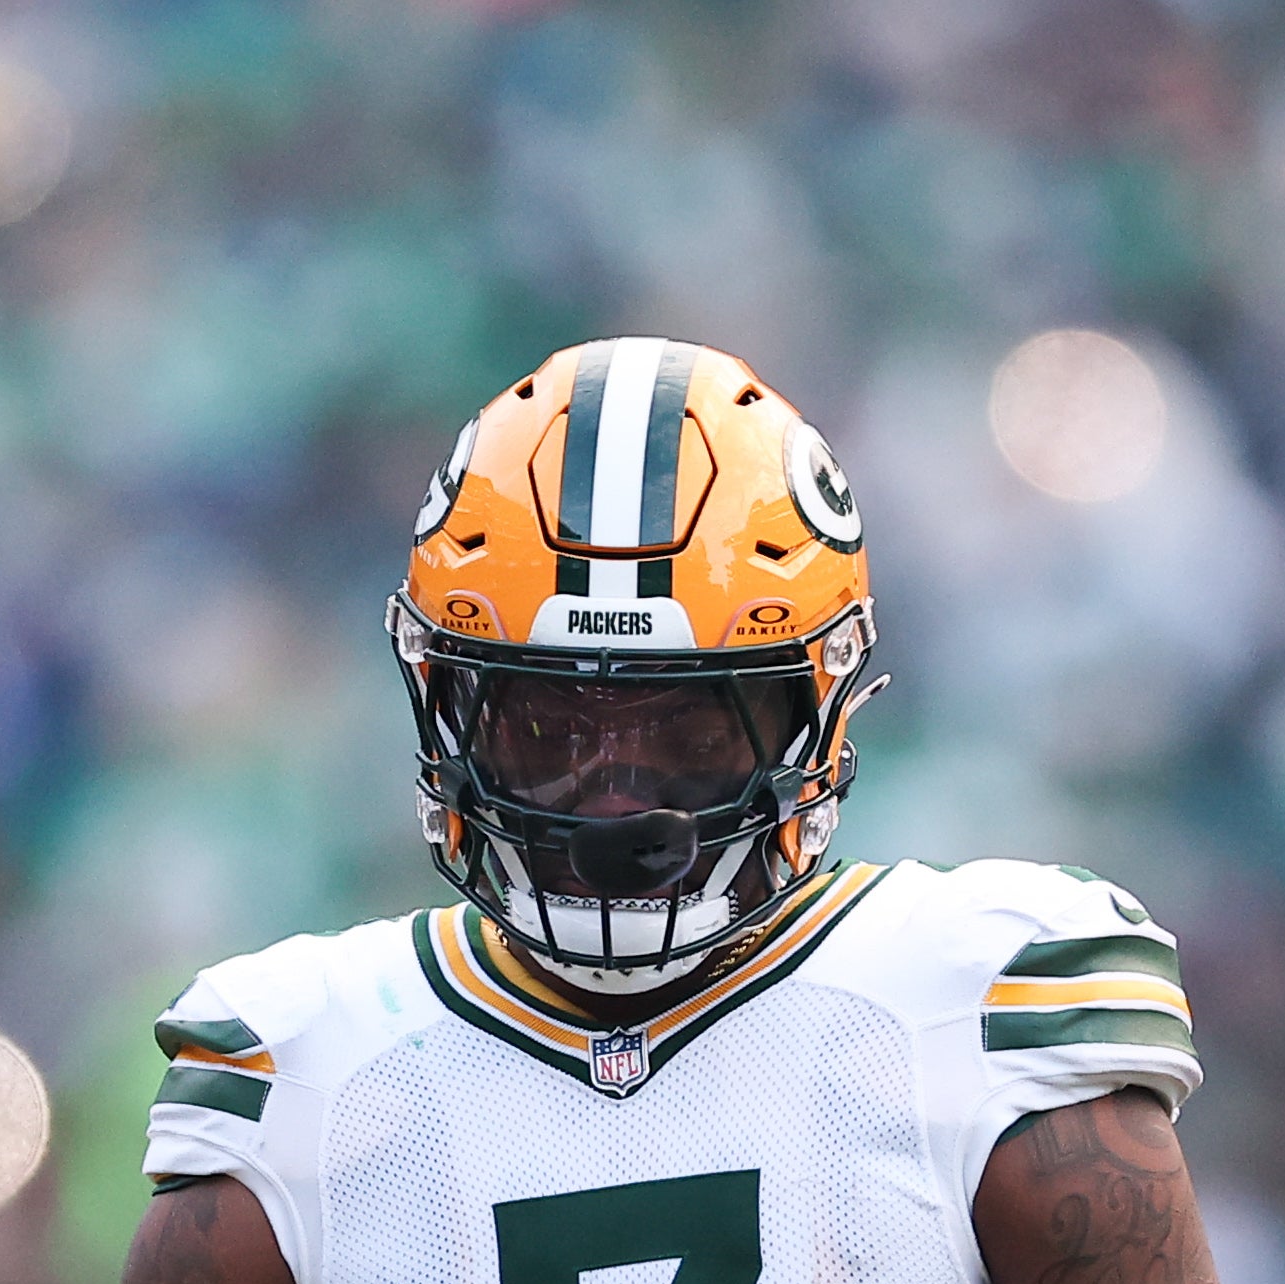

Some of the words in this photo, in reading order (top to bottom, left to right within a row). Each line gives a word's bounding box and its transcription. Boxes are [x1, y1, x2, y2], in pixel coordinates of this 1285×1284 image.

[441, 617, 491, 632] OAKLEY
[567, 609, 654, 636] PACKERS
[735, 624, 798, 636] OAKLEY
[598, 1051, 639, 1082] NFL
